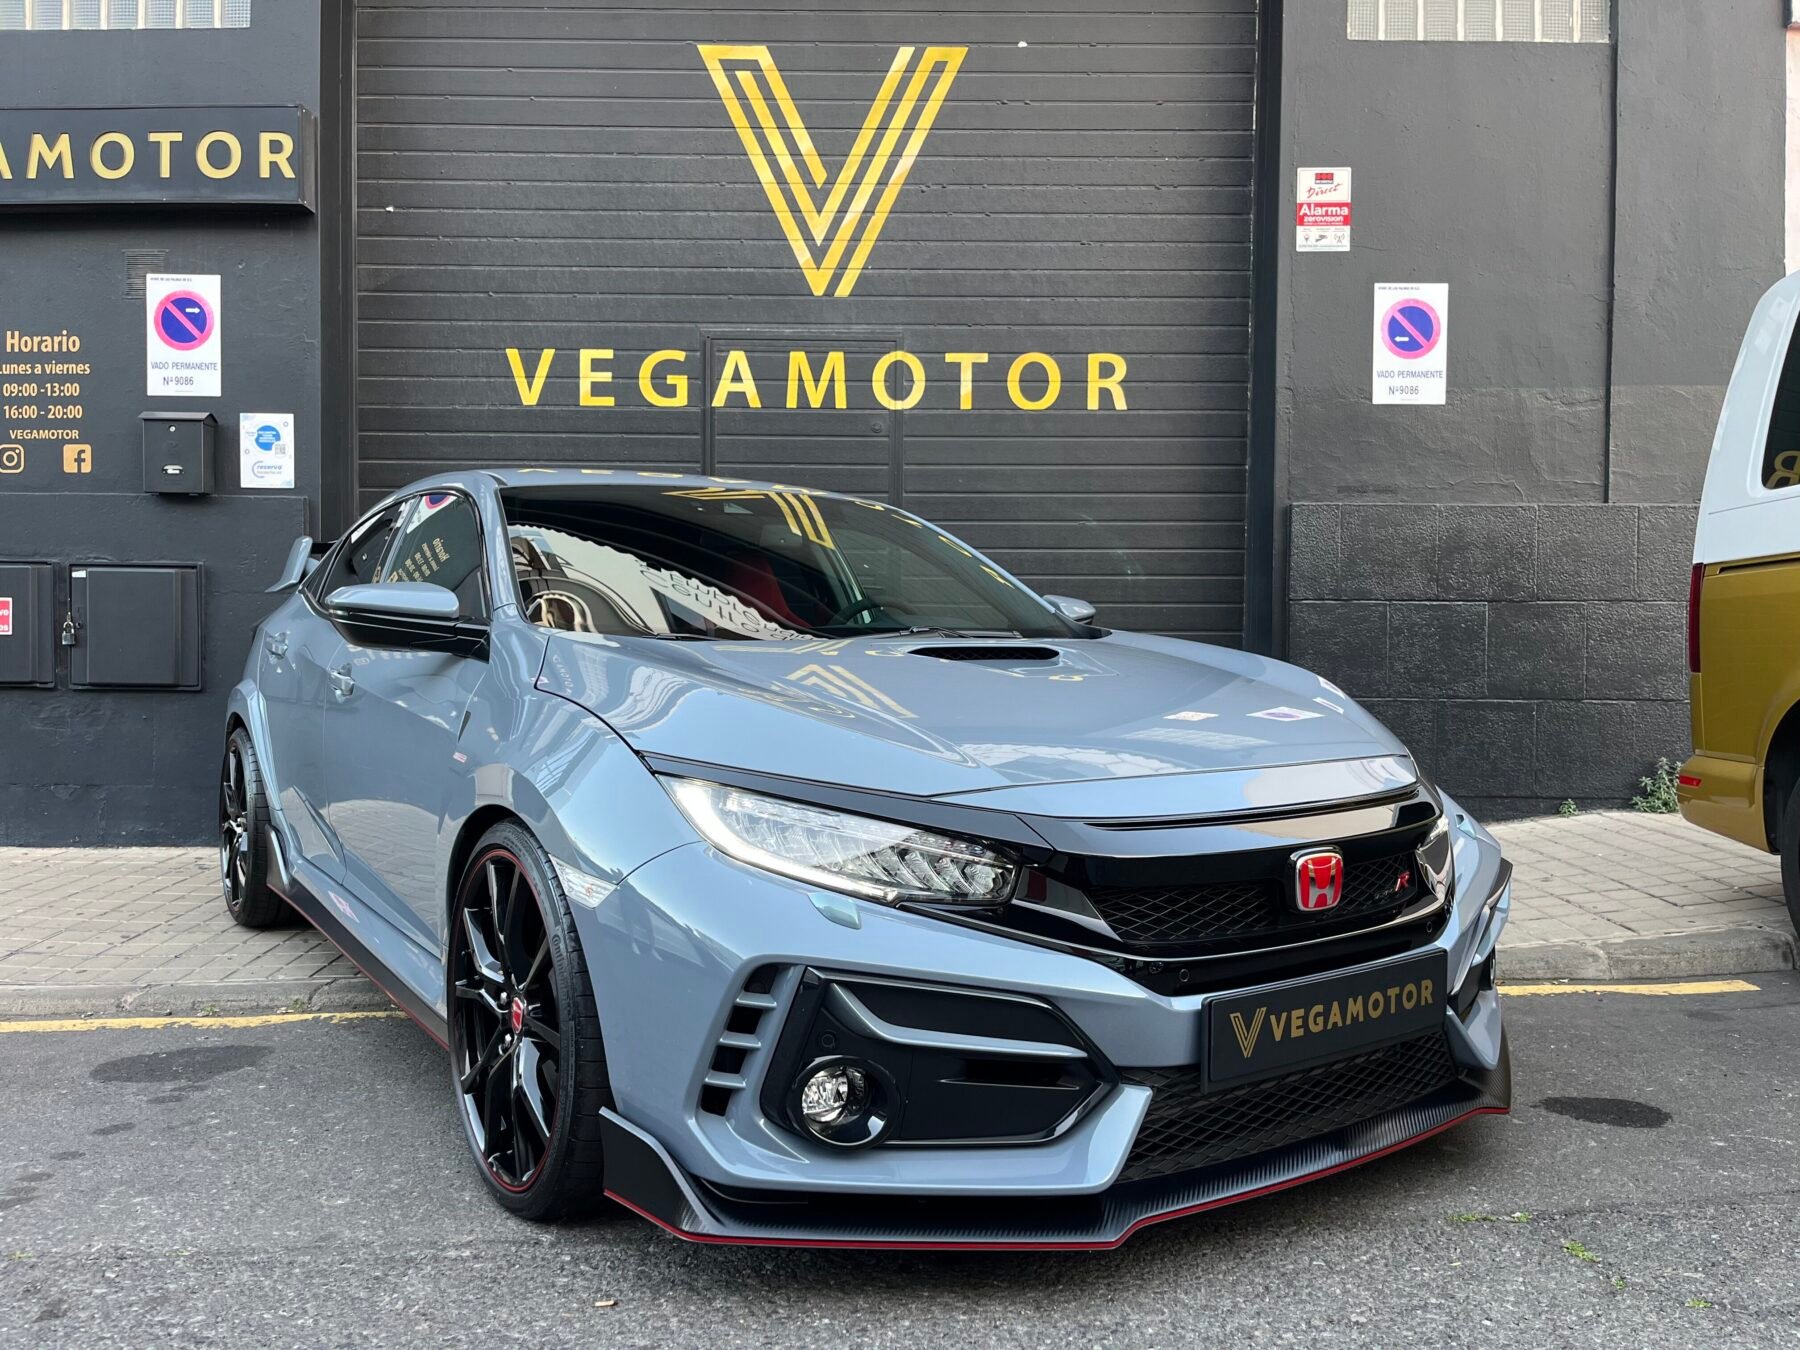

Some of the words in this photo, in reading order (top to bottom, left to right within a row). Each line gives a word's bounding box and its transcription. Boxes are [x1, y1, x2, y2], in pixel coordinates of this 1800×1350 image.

[1299, 203, 1349, 216] Alarma
[6, 330, 80, 353] Horario
[34, 364, 42, 375] a
[45, 360, 91, 375] viernes
[151, 361, 169, 370] VADO
[171, 361, 218, 371] PERMANENTE
[505, 348, 1129, 411] VEGAMOTOR
[1376, 370, 1395, 379] VADO
[1397, 370, 1443, 379] PERMANENTE
[3, 383, 38, 397] 09:00
[3, 405, 38, 419] 16:00
[47, 405, 83, 419] 20:00
[9, 429, 80, 440] VEGAMOTOR
[1270, 979, 1434, 1042] VEGAMOTOR
